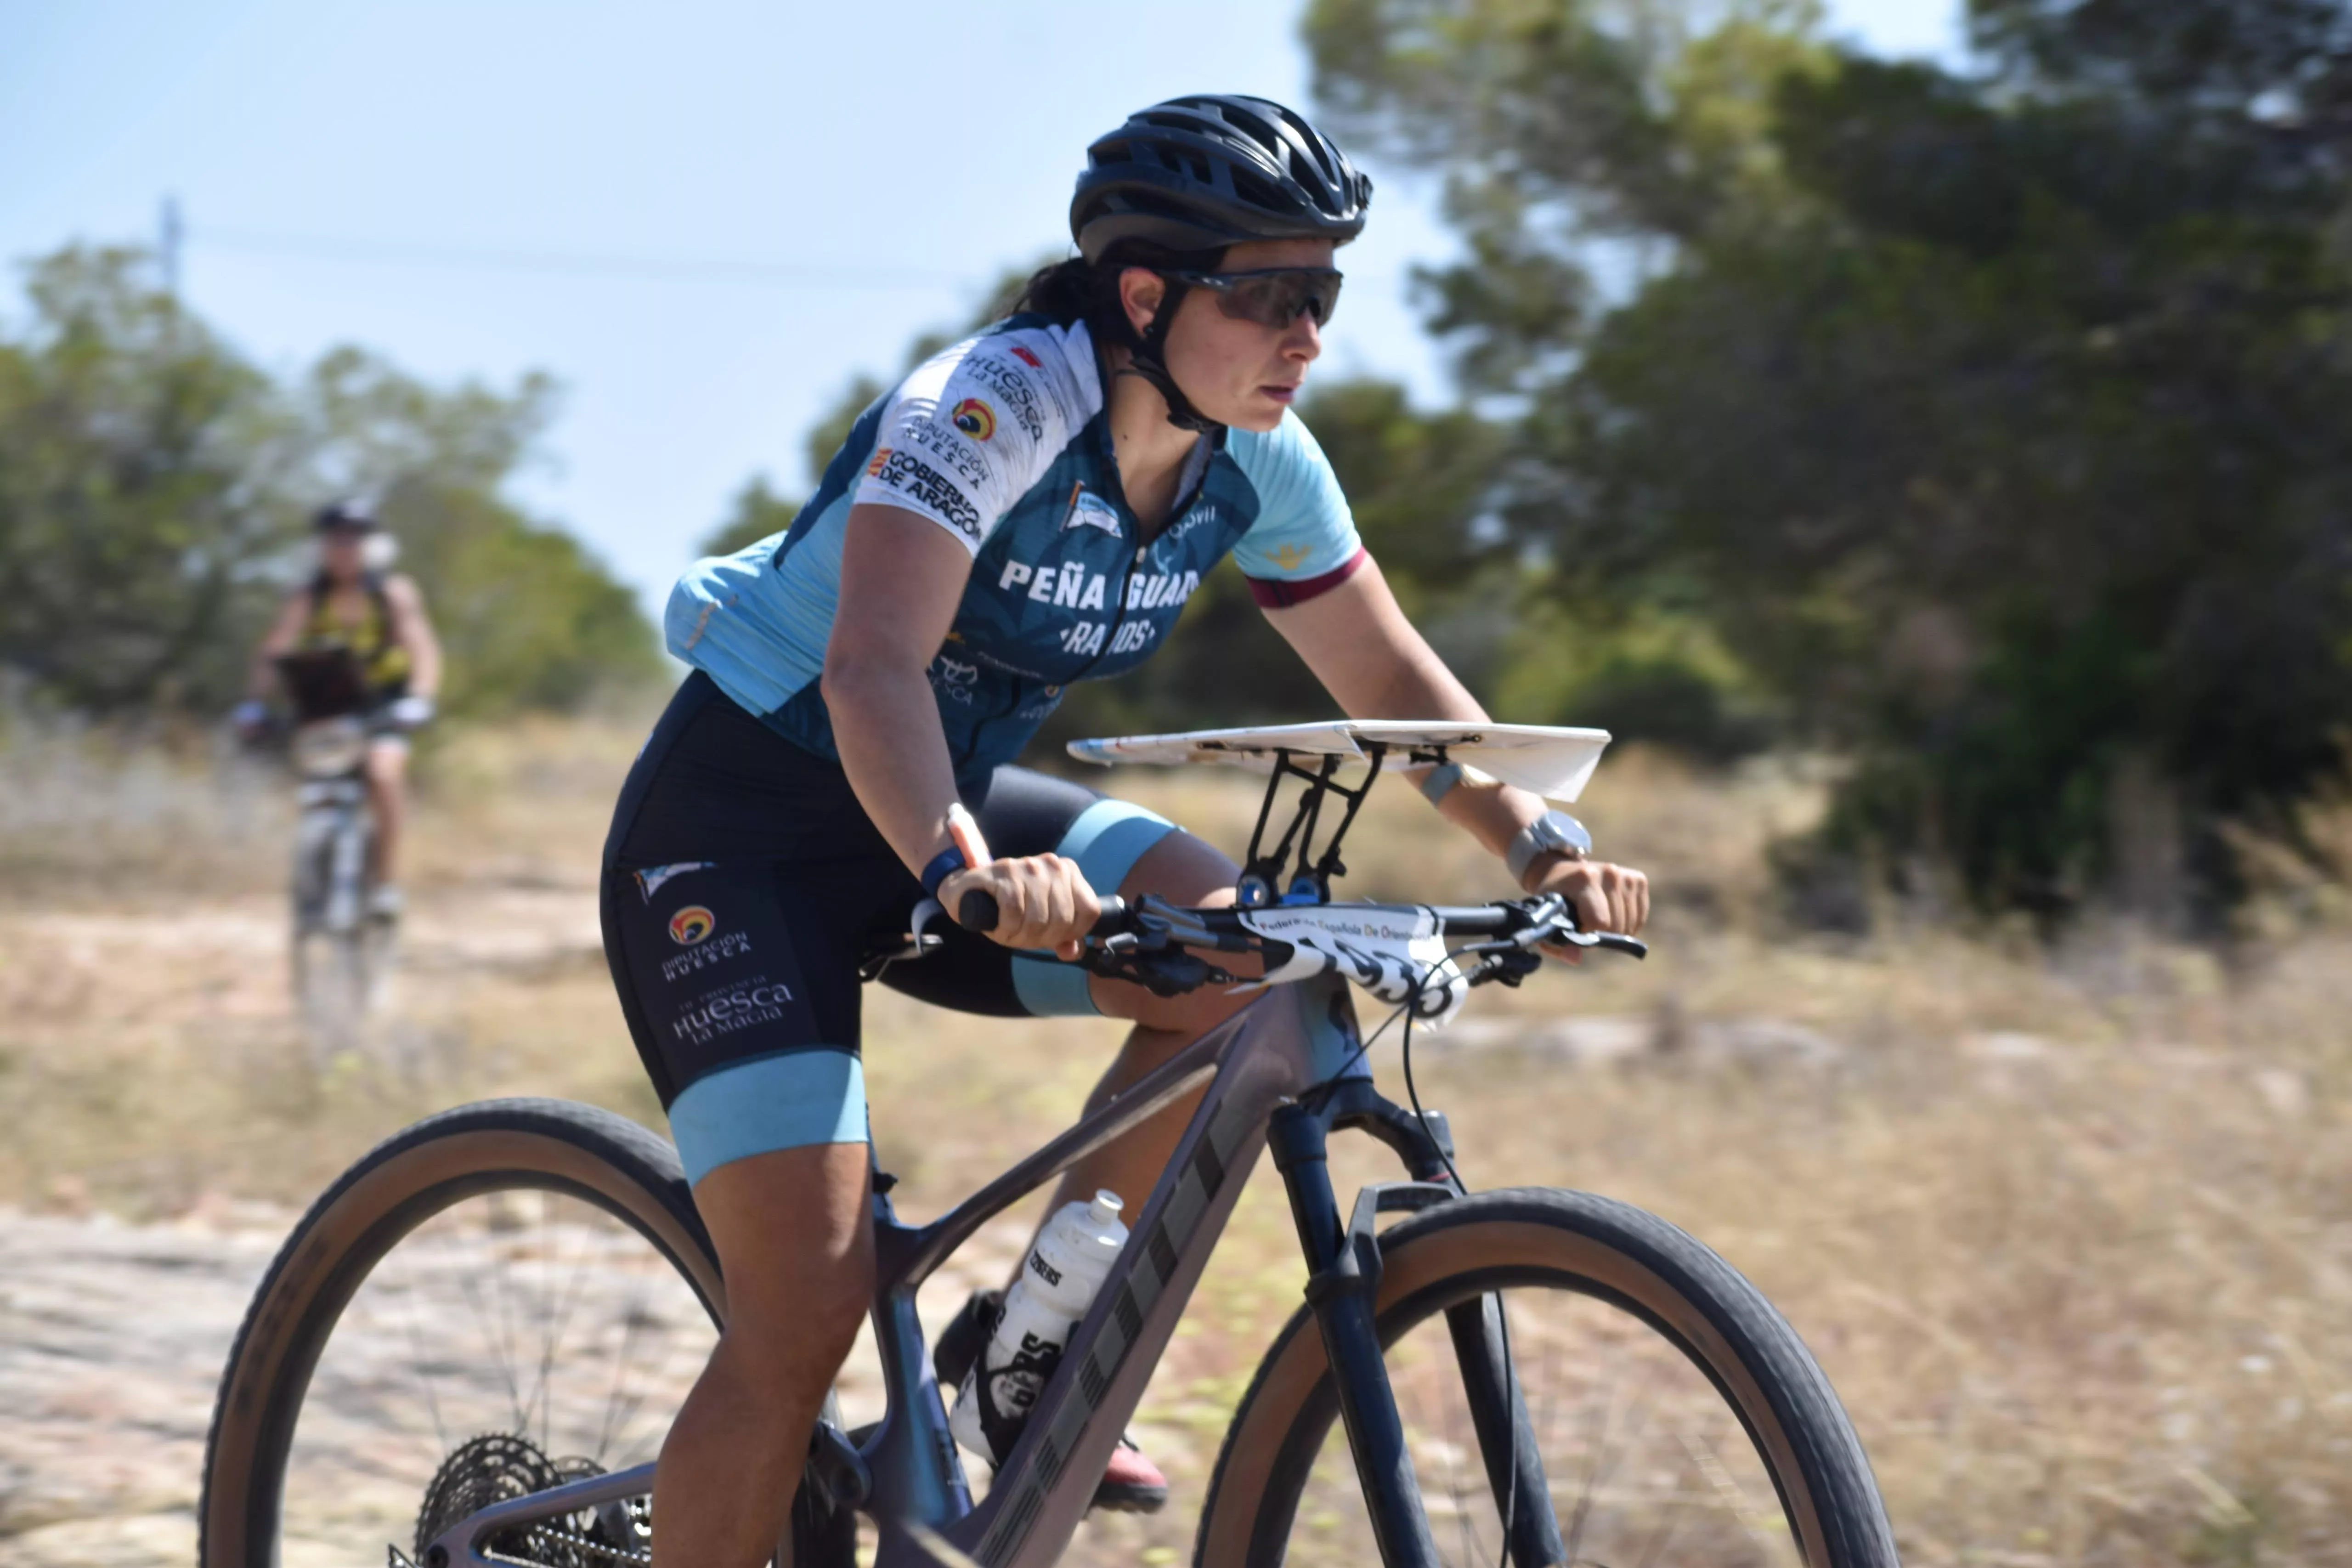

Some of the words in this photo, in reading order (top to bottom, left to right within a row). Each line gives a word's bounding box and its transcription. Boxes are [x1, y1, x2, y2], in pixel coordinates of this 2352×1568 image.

[879, 466, 905, 488] DE
[889, 451, 979, 523] GOBIERNO
[999, 559, 1106, 610] PEÑA
[1364, 924, 1378, 937] De
[672, 983, 793, 1040] Huesca
